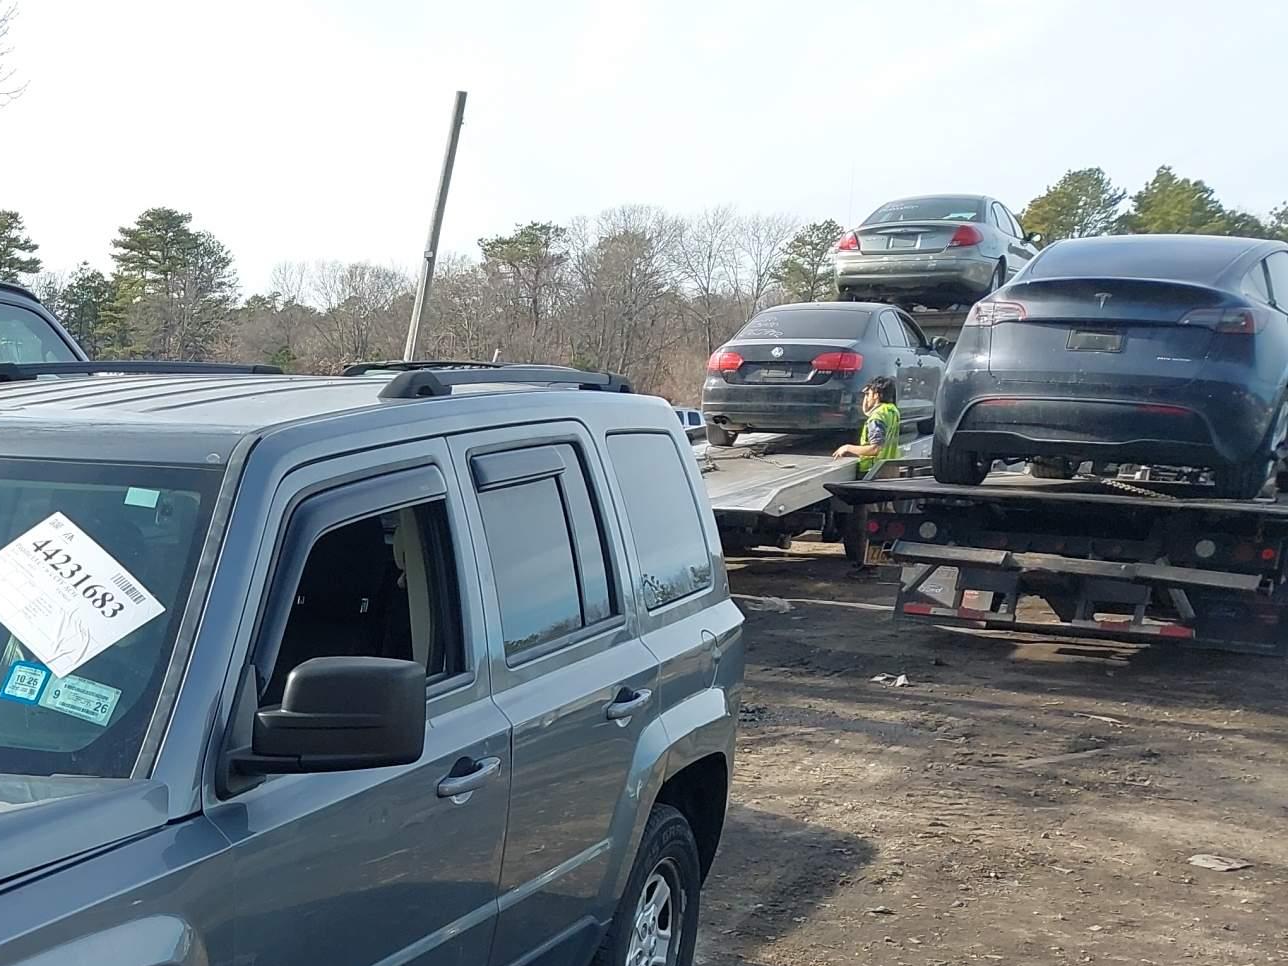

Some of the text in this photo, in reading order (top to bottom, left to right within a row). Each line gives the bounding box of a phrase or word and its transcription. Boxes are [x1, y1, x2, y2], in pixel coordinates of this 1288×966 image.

[31, 538, 125, 619] 44231683
[52, 689, 61, 700] 9
[93, 701, 109, 714] 26
